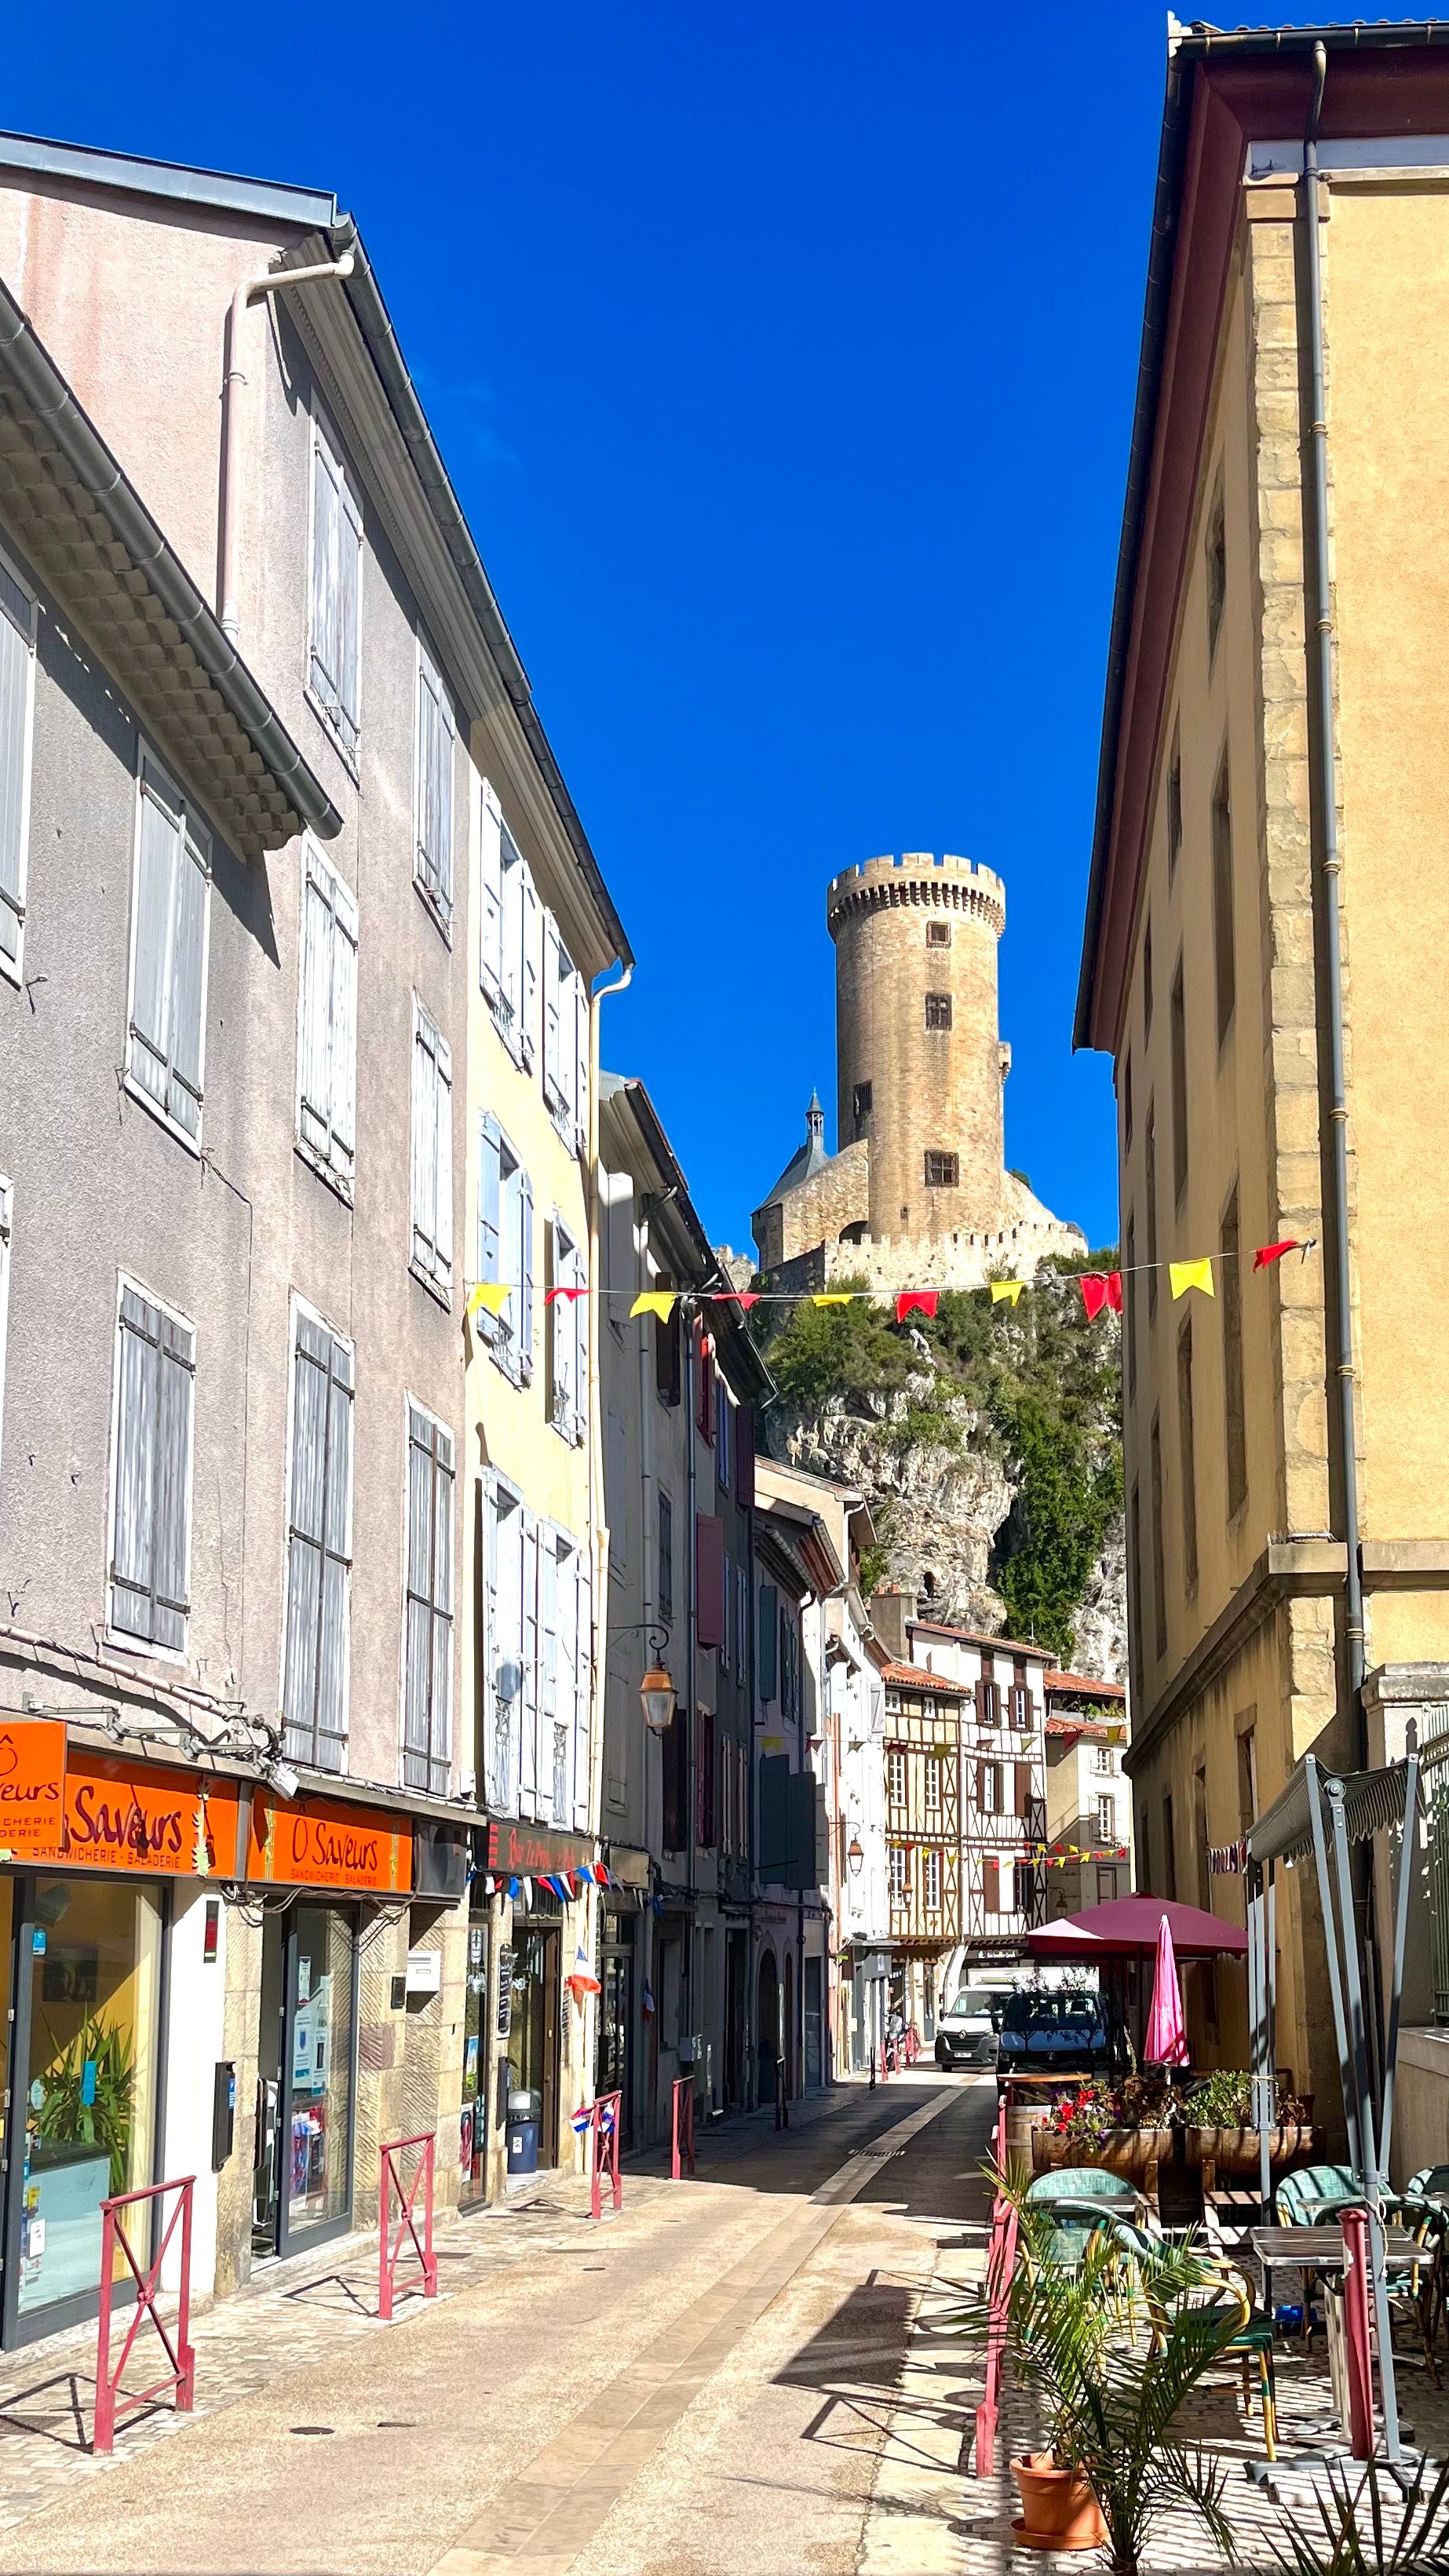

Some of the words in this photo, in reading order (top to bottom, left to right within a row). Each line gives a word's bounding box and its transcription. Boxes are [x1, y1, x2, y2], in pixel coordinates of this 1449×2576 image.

[0, 1781, 60, 1801] eurs
[0, 1817, 57, 1826] CHERIE
[70, 1785, 182, 1854] Saveurs
[312, 1822, 378, 1871] Saveurs
[32, 1847, 116, 1863] SANDWICHERIE
[127, 1852, 180, 1869] SALADERIE
